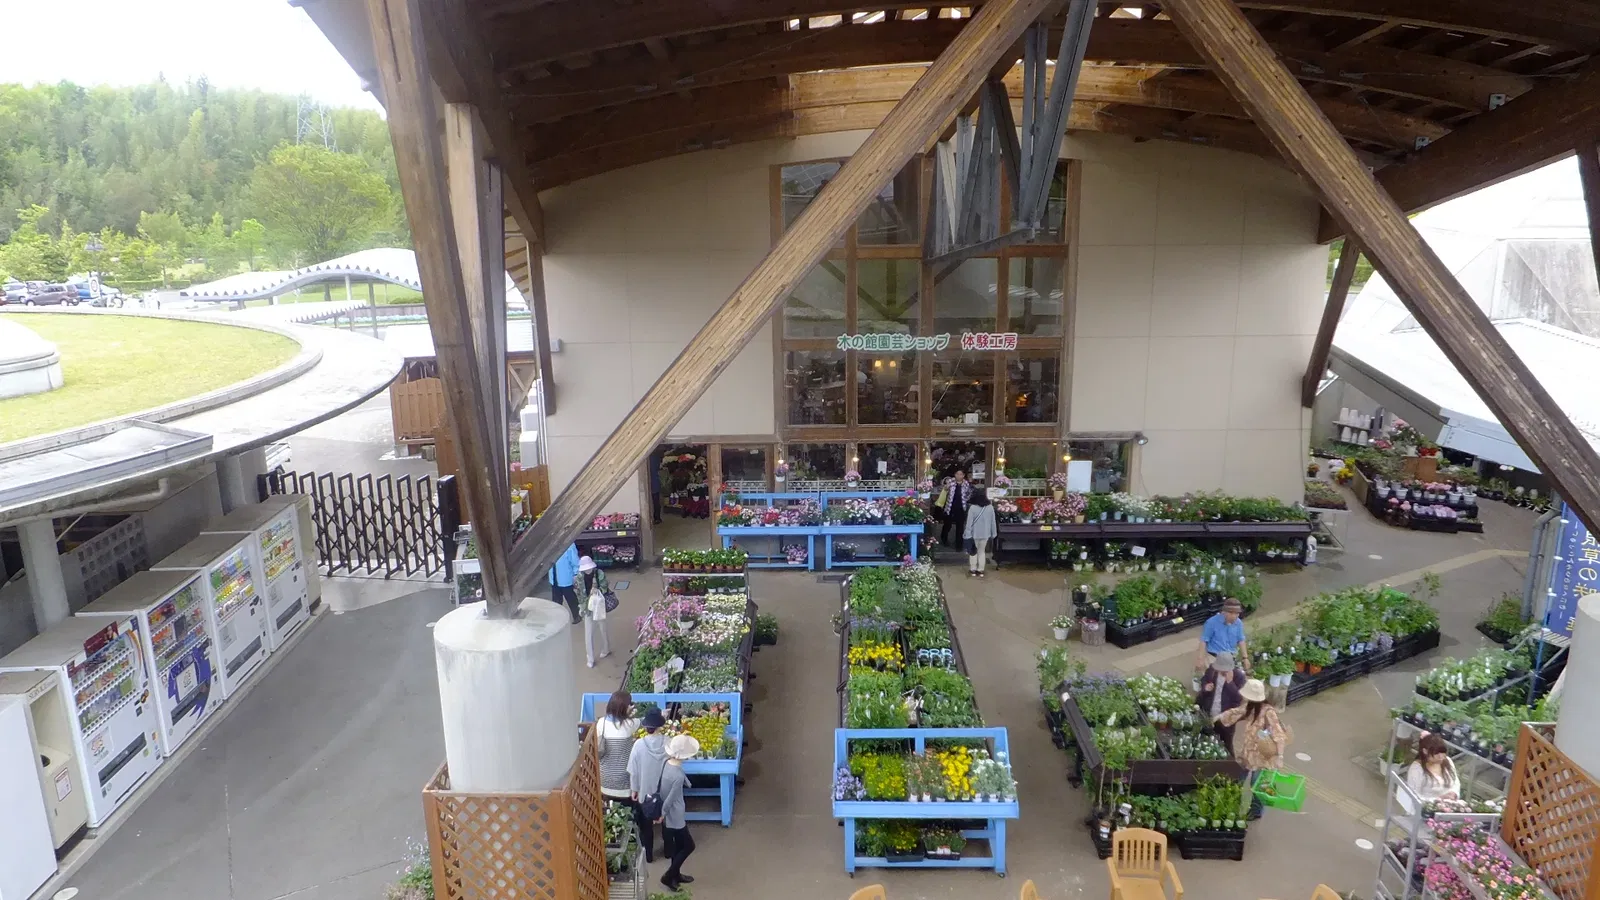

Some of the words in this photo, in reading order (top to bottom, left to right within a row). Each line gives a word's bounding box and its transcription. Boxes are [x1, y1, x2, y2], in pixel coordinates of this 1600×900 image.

[837, 333, 950, 350] 木の館園芸ショップ
[961, 332, 1018, 350] 体験工房
